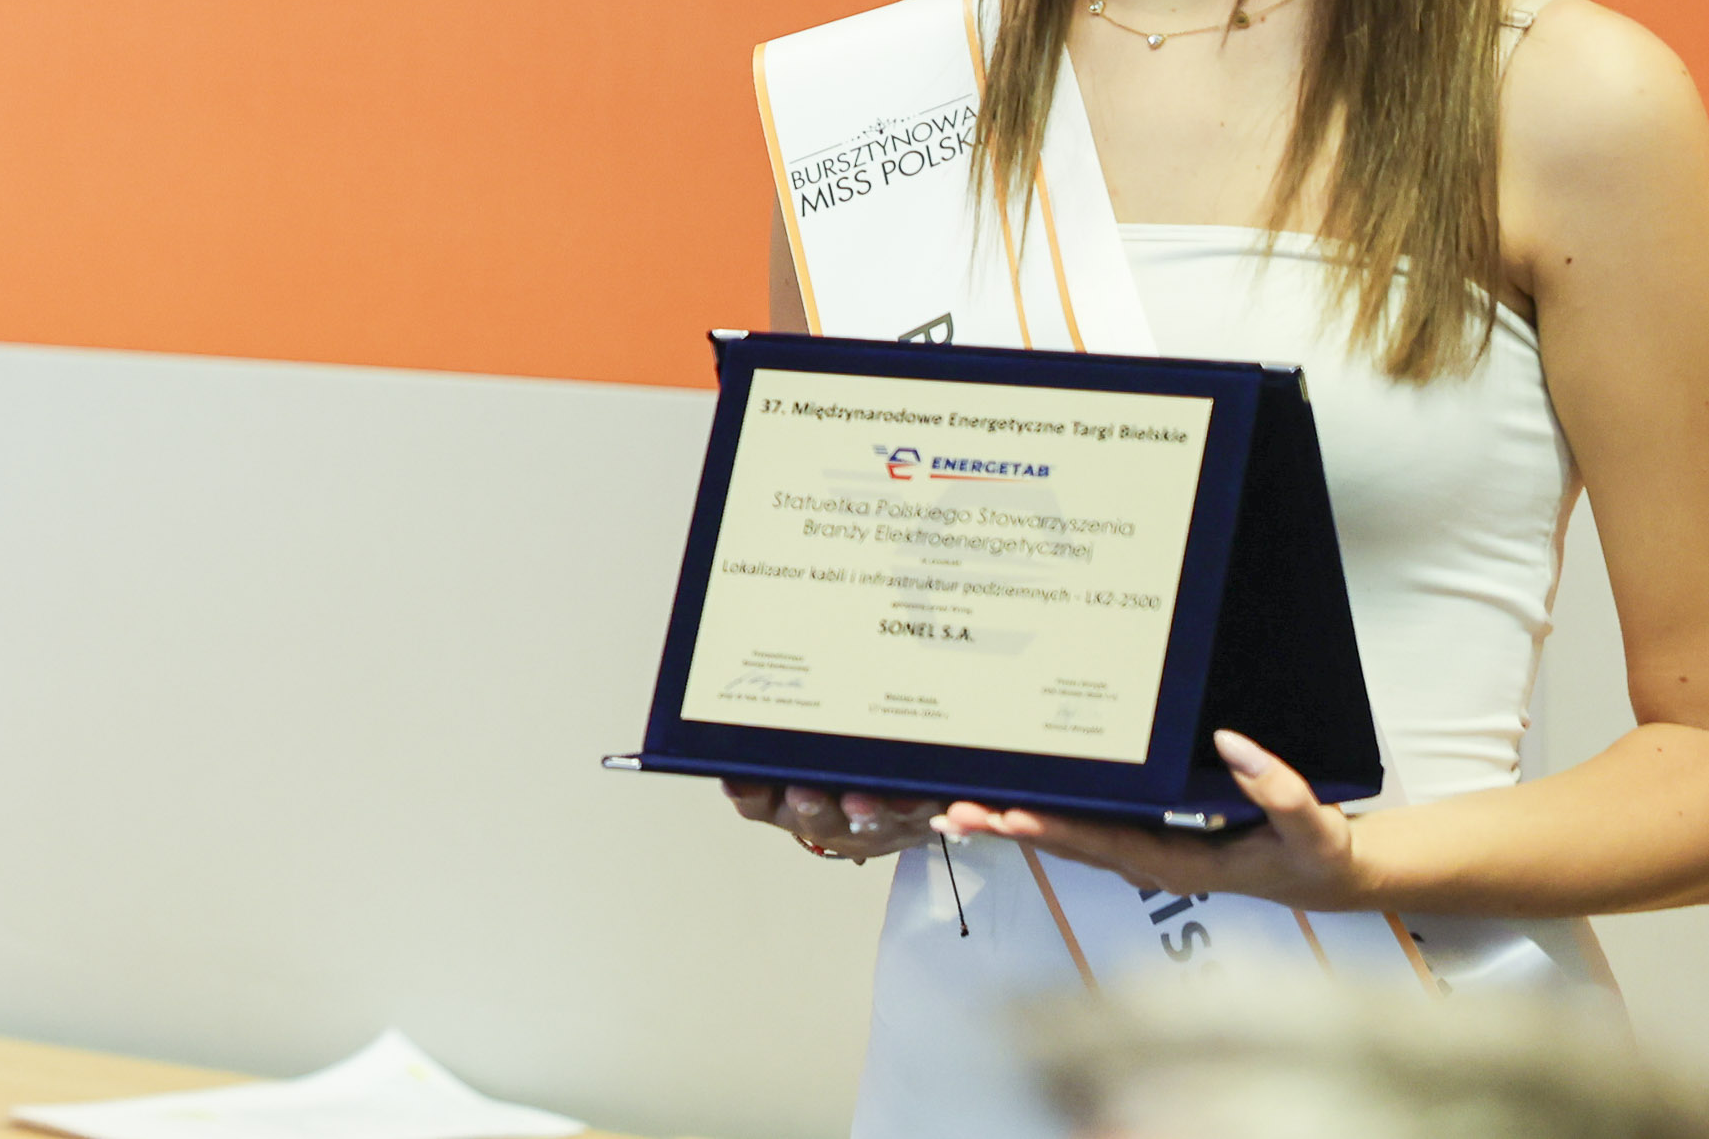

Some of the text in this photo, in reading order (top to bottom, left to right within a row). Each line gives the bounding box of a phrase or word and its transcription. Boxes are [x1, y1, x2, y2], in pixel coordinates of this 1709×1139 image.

[791, 105, 978, 191] BURSZTYNOWA
[801, 168, 873, 218] MISS
[760, 399, 1188, 444] 37. Międzynarodowe Energetyczne Targi Bielskie
[931, 456, 1051, 477] ENERGETAB
[772, 491, 1136, 536] Statuetka Polskiego Stowarzyszenia
[802, 518, 1094, 563] Branży Elektroenergetycznej
[722, 559, 805, 579] Lokalizator
[859, 570, 959, 591] infrastruktur
[963, 581, 1071, 605] podziemnych
[877, 618, 974, 642] SONEL S.A.
